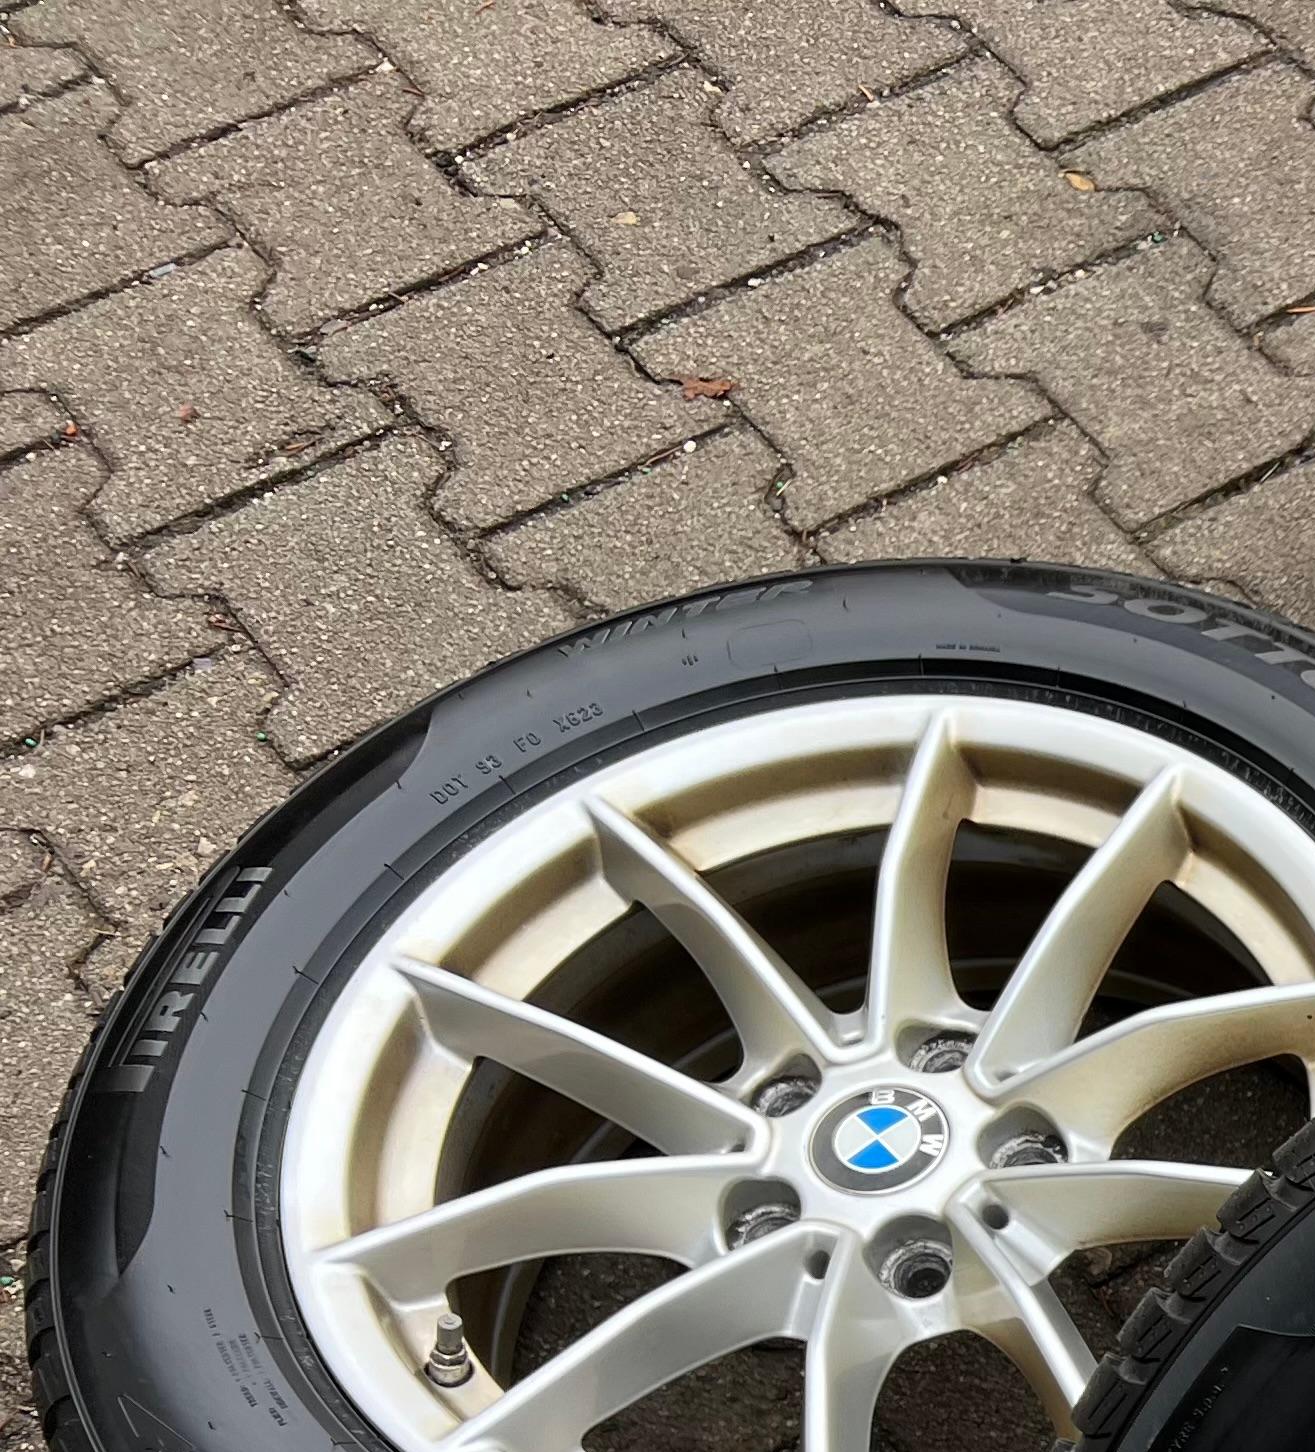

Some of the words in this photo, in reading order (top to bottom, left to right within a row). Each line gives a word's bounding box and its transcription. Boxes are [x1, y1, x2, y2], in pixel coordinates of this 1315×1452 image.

[558, 580, 812, 657] WINTER
[428, 774, 469, 807] DOT
[100, 866, 273, 1093] PIRELLI
[868, 1089, 945, 1158] BMW
